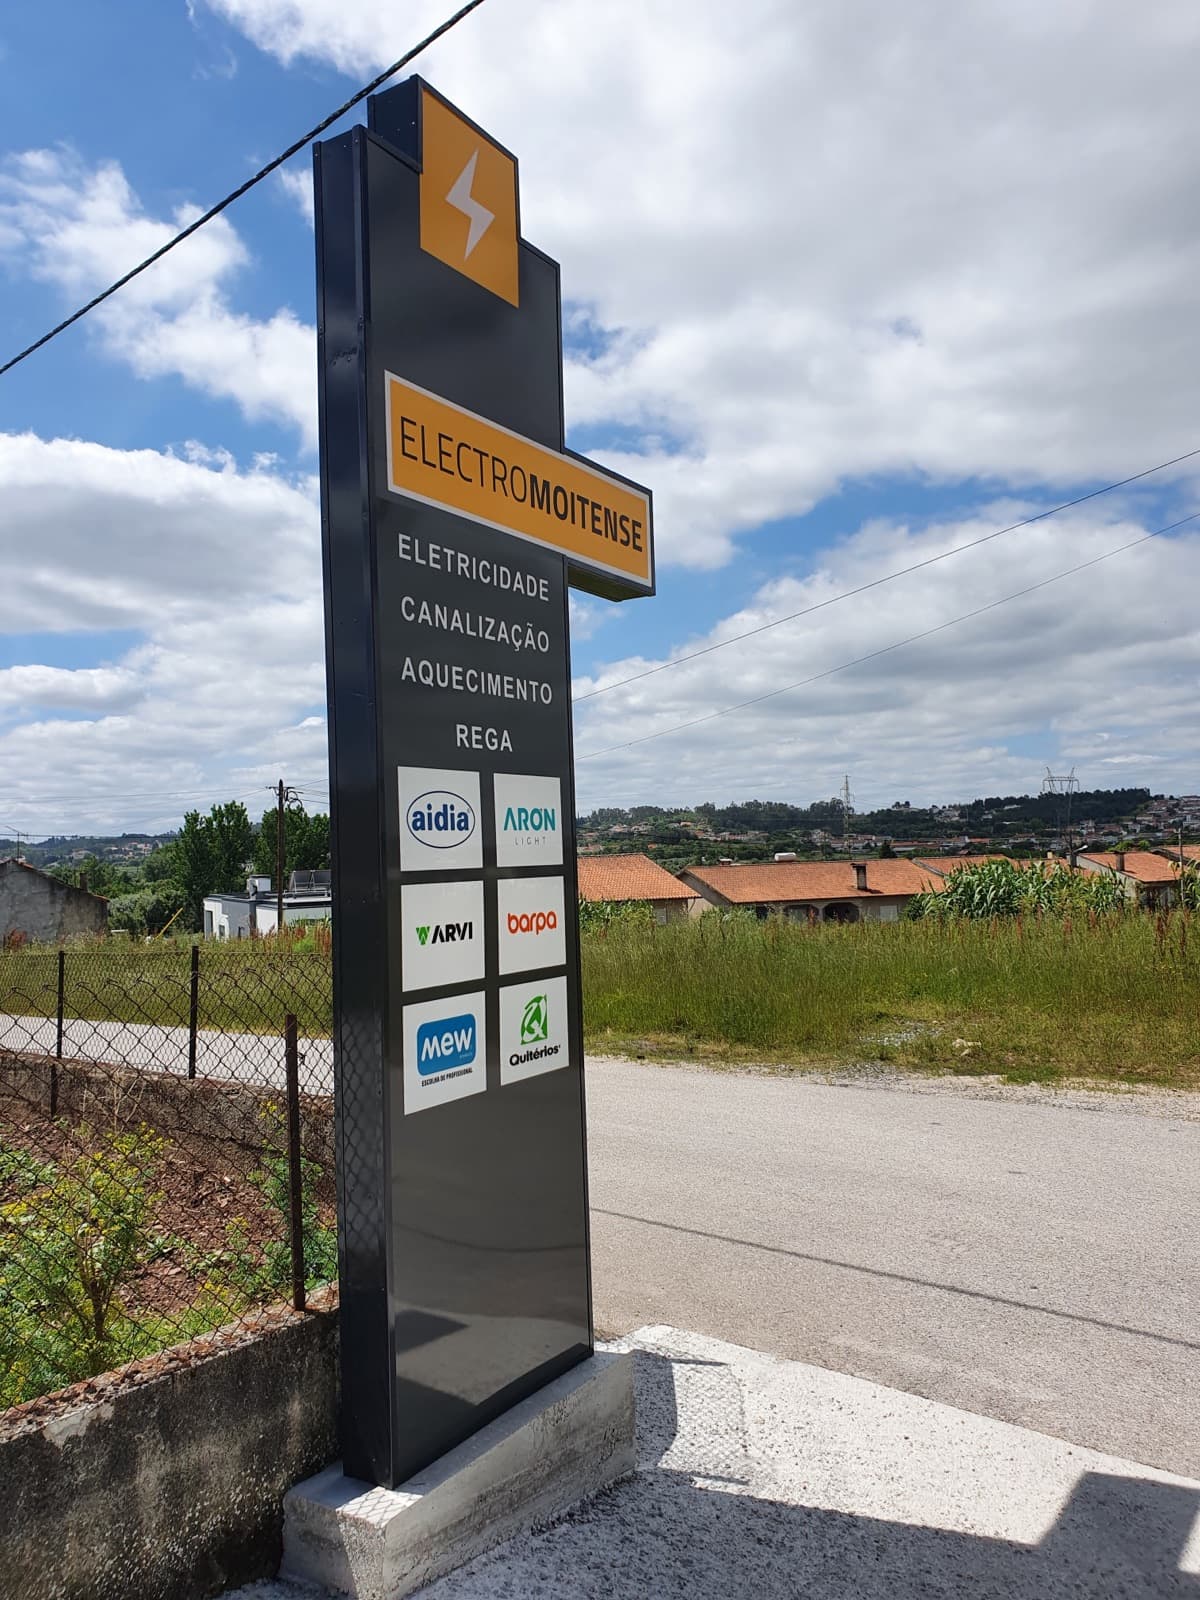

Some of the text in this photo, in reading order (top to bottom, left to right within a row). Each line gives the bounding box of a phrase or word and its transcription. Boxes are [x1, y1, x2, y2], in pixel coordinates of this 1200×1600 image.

[400, 415, 643, 552] ELECTROMOITENSE
[398, 533, 549, 601] ELETRICIDADE
[401, 596, 549, 653] CANALIZAÇÃO
[401, 657, 552, 705] AQUECIMENTO
[456, 723, 513, 752] REGA
[411, 803, 469, 832] aidia
[503, 807, 556, 831] ARON
[514, 836, 547, 846] LIGHT
[507, 910, 557, 935] barpa
[509, 1045, 560, 1067] Quitérios
